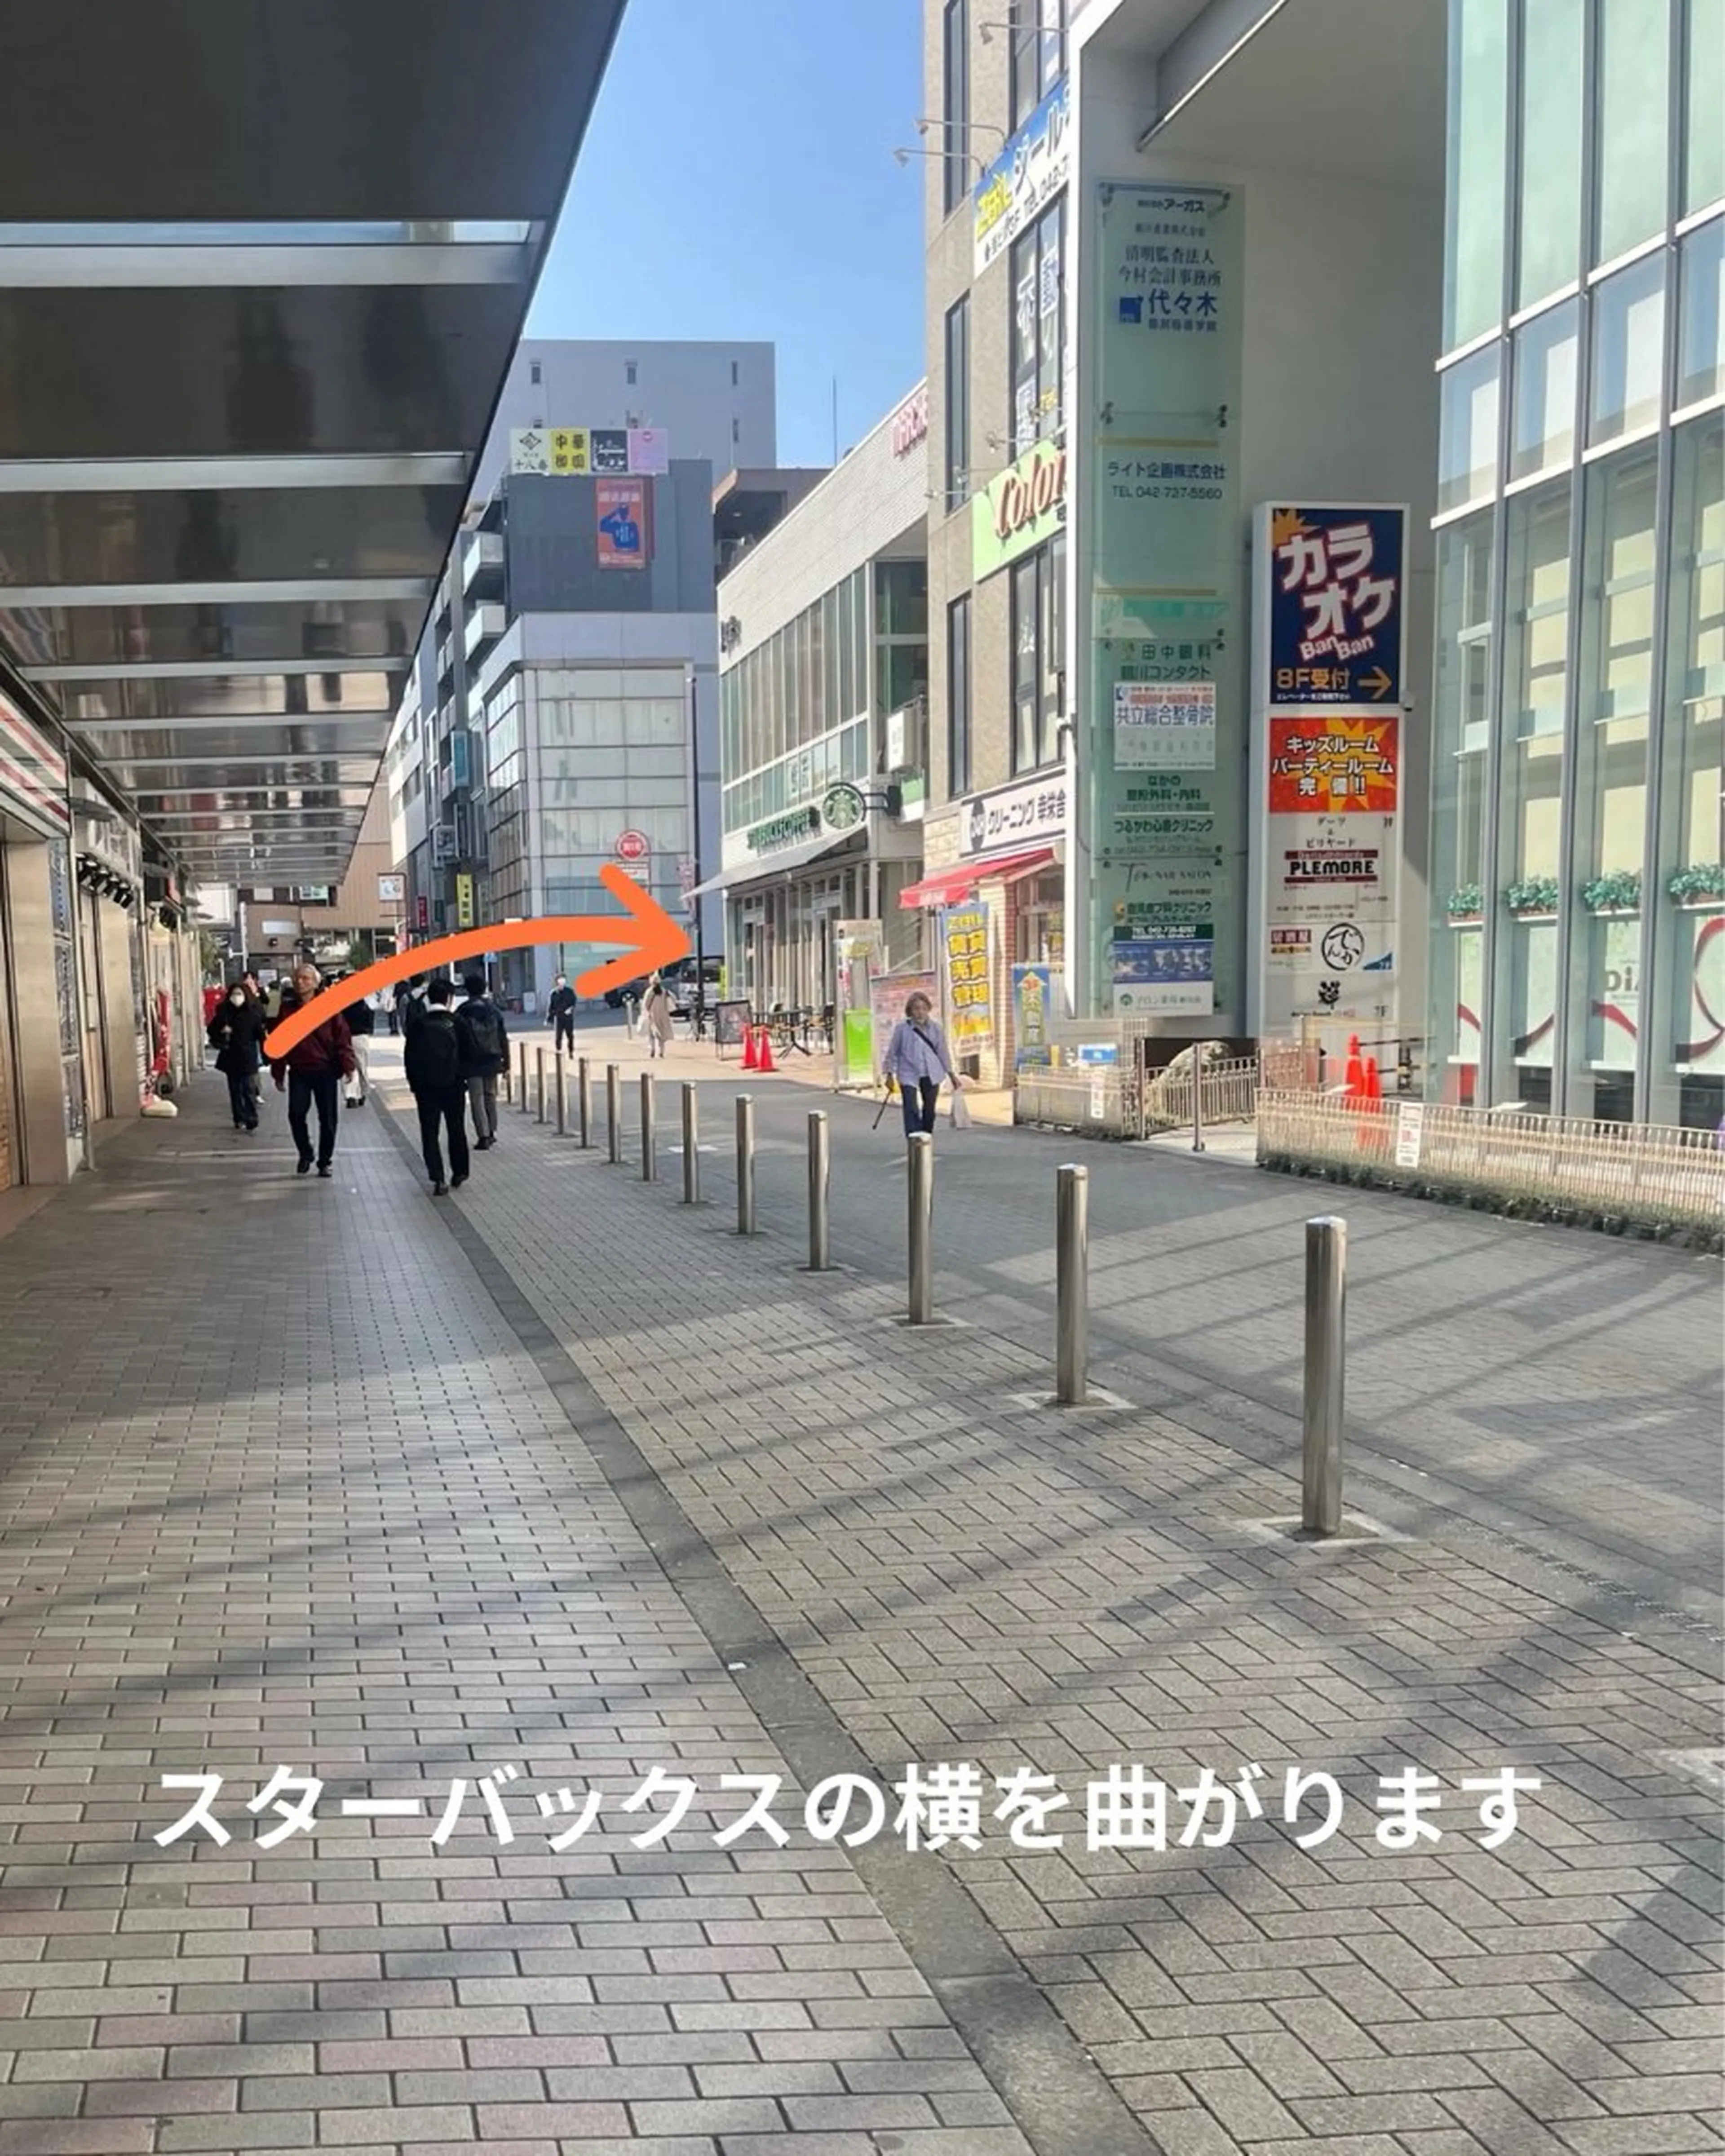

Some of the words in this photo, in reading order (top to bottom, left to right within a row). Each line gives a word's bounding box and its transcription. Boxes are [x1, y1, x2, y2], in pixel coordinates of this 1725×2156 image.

[1148, 288, 1217, 316] 代々木
[1112, 486, 1132, 498] TEL
[1299, 635, 1375, 660] BanBan
[1287, 736, 1379, 753] キッズルーム
[988, 798, 1034, 836] クリーニング
[1306, 839, 1356, 848] ビリヤード
[1290, 860, 1375, 875] PLEMORE
